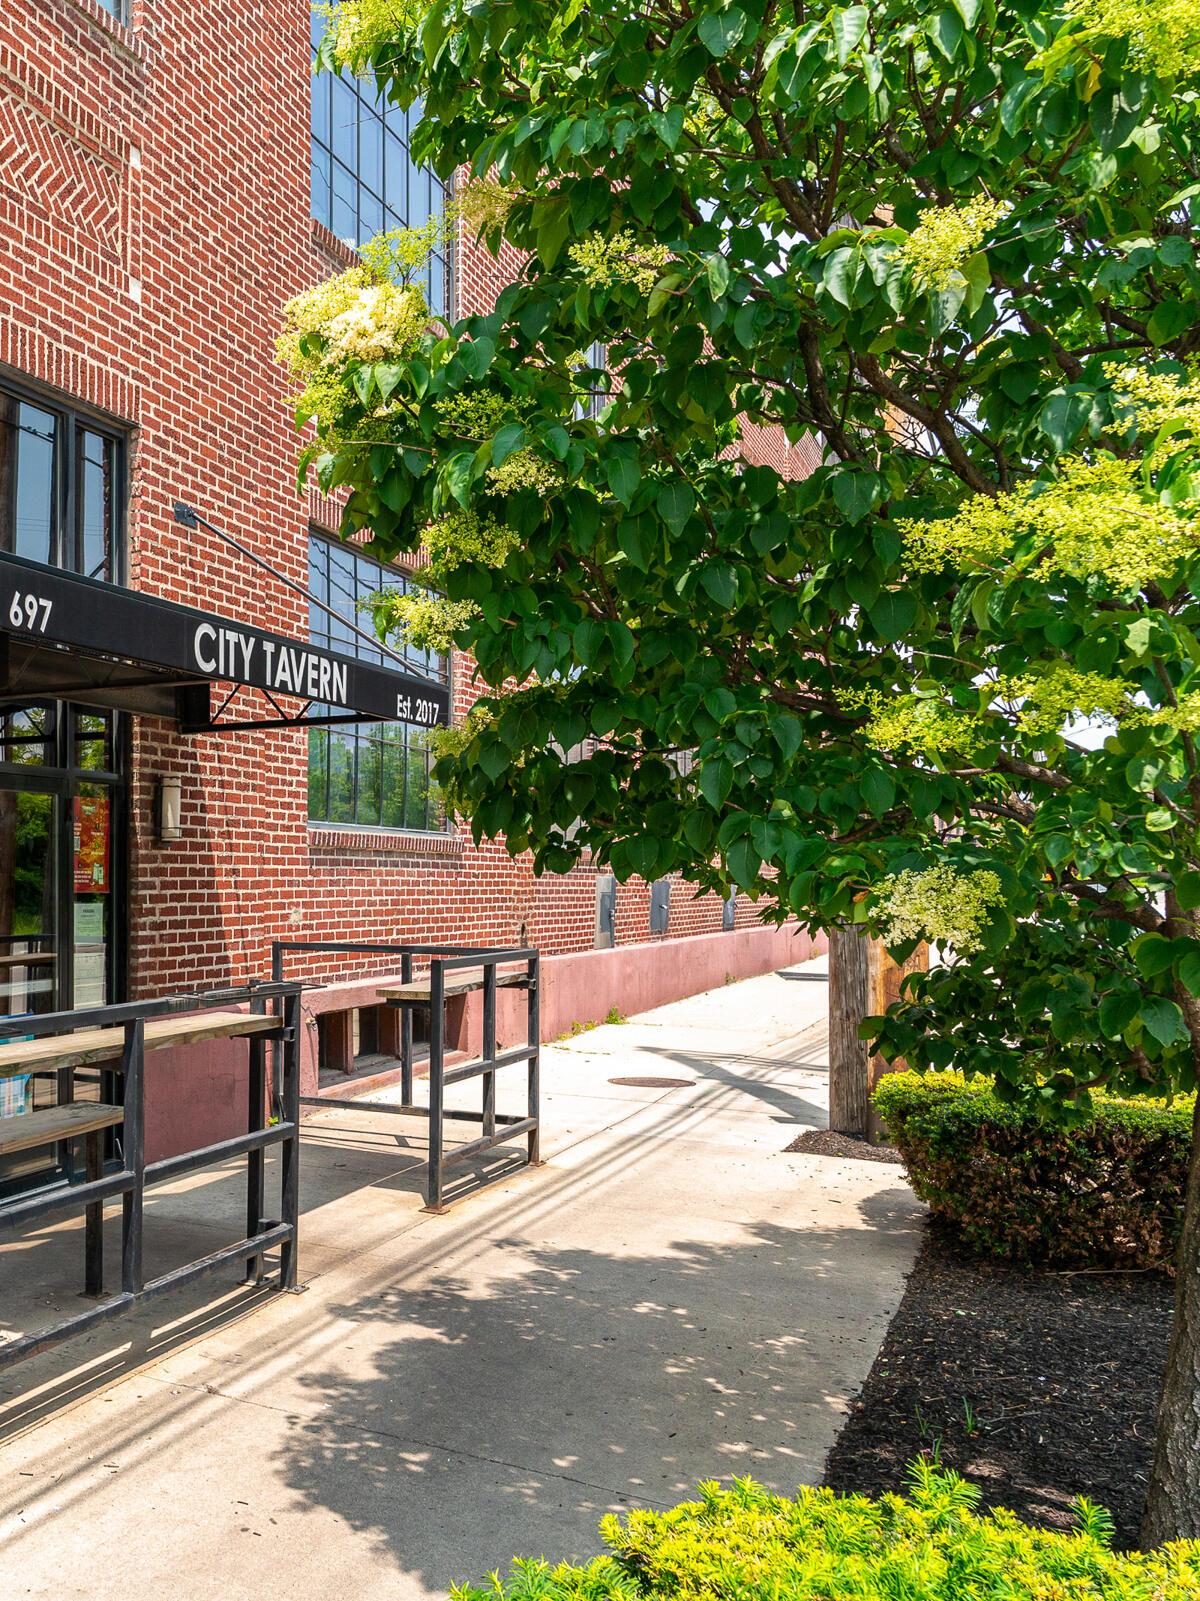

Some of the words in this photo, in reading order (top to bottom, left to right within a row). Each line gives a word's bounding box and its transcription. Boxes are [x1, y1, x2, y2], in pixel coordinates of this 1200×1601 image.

[8, 590, 53, 634] 697
[194, 622, 256, 680] CITY
[263, 641, 347, 705] TAVERN
[396, 694, 412, 720] Est.
[415, 699, 439, 726] 2017
